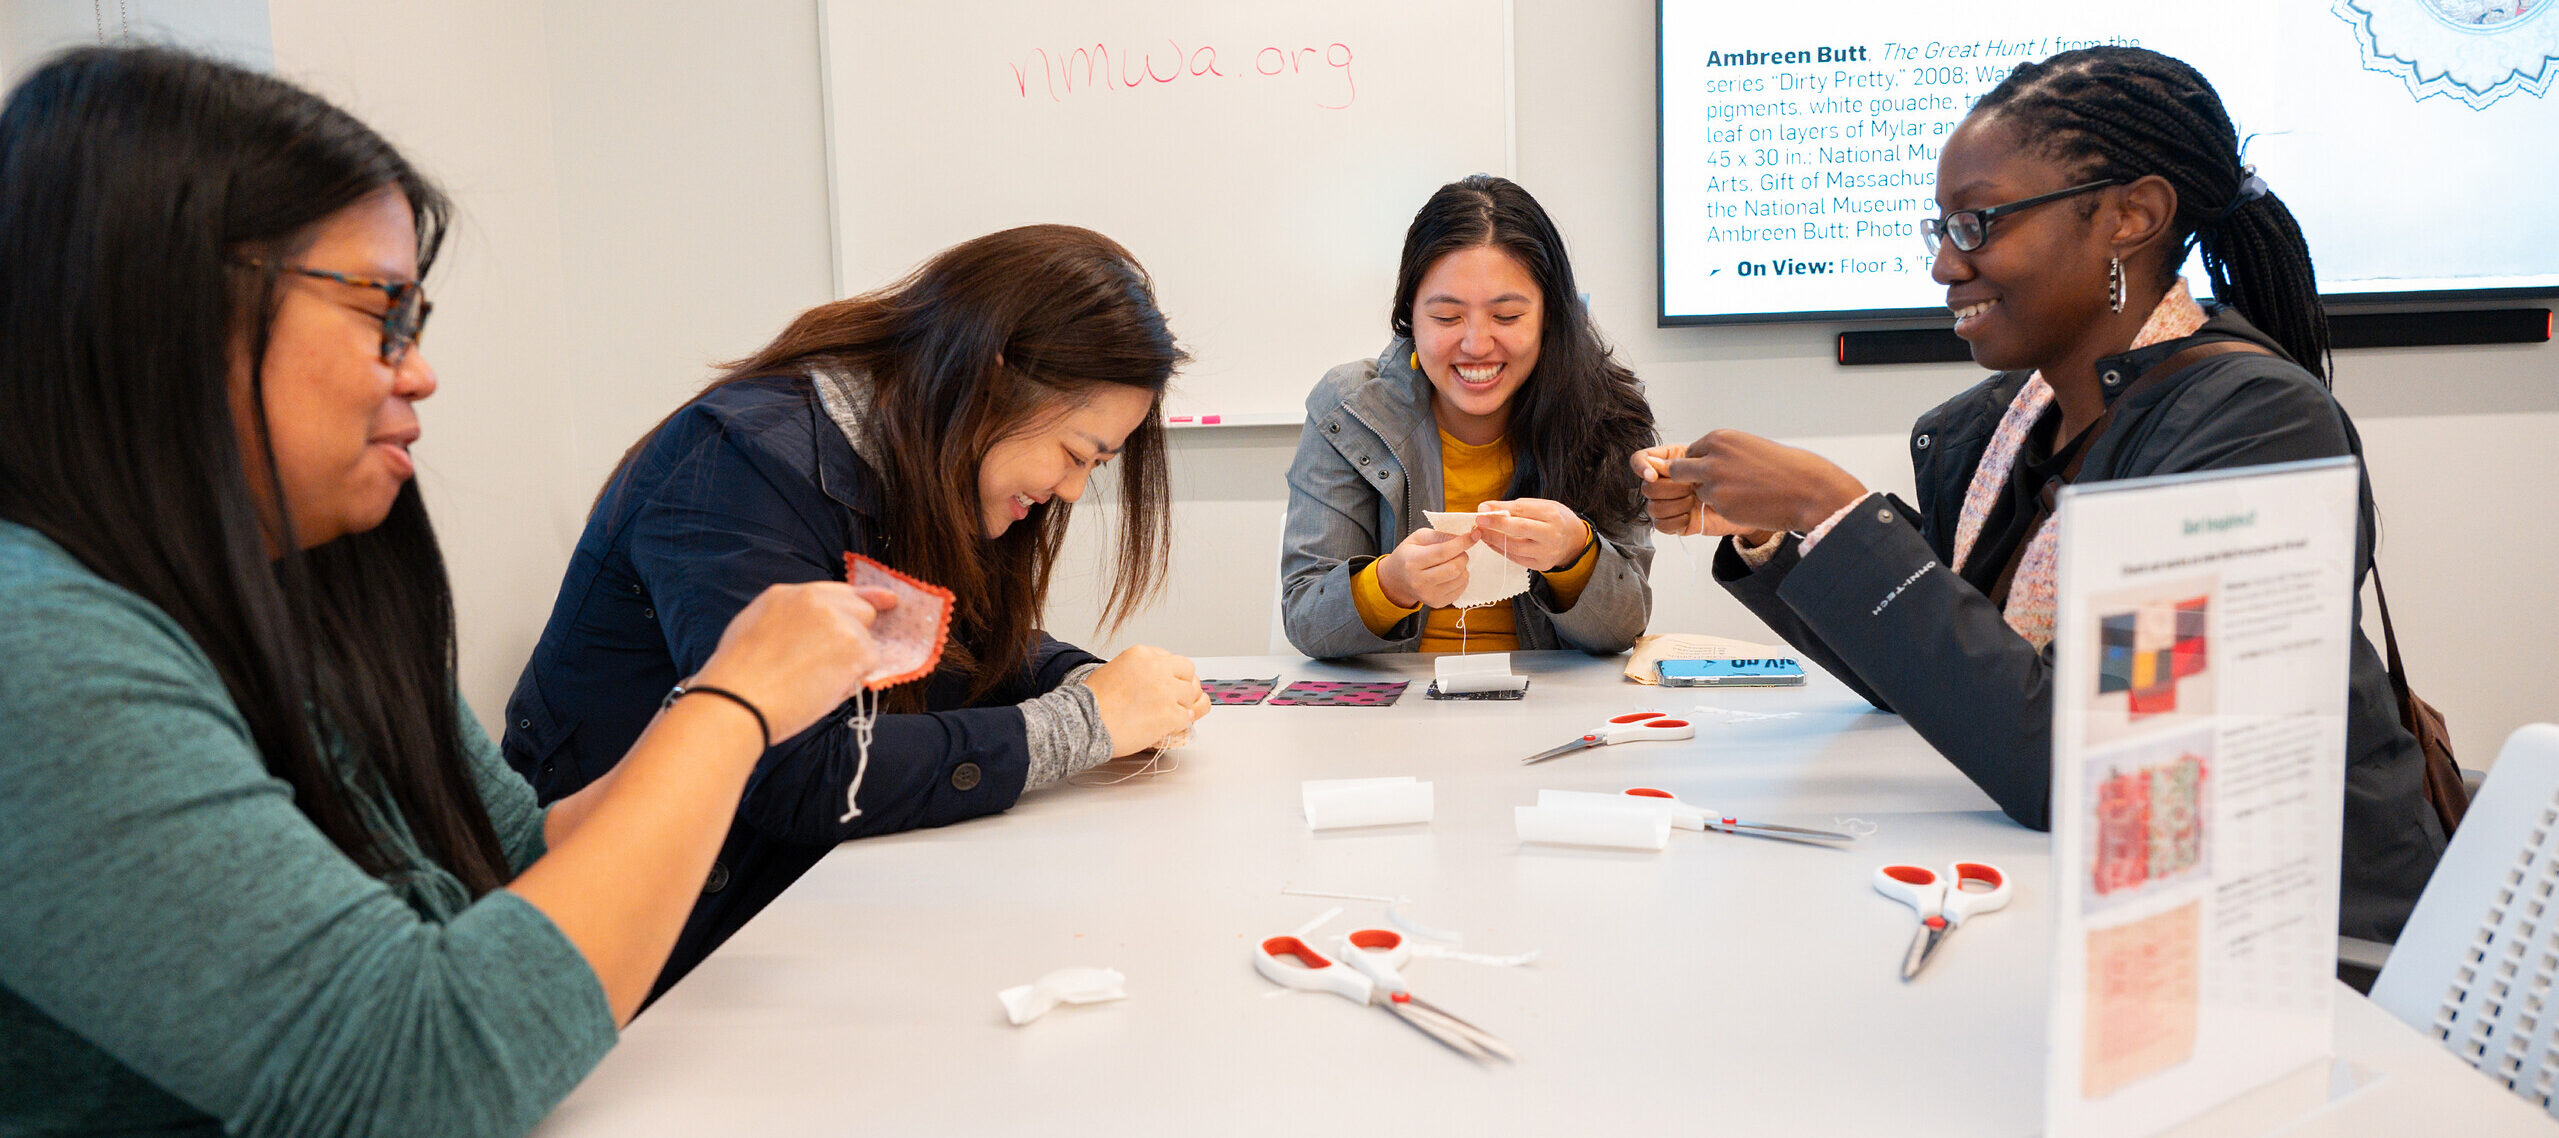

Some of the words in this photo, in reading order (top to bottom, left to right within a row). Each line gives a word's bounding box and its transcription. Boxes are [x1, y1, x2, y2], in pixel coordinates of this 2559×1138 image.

[1706, 49, 1811, 67] Ambreen
[1884, 42, 1919, 61] The
[1924, 40, 1980, 60] Great
[1985, 39, 2036, 57] Hunt
[1009, 39, 1355, 109] nmwa.org
[1706, 74, 1764, 94] series
[1913, 66, 1969, 87] 2008;
[1809, 97, 1863, 115] white
[1706, 124, 1744, 144] leaf
[1749, 130, 1773, 142] on
[1779, 123, 1840, 145] layers
[1845, 120, 1866, 139] of
[1870, 119, 1927, 142] Mylar
[1706, 150, 1732, 168] 45
[1738, 153, 1748, 167] x
[1754, 148, 1779, 167] 30
[1819, 144, 1901, 165] National
[1760, 172, 1795, 192] Gift
[1801, 171, 1821, 190] of
[1826, 168, 1936, 189] Massachus
[1707, 201, 1739, 218] the
[1744, 198, 1826, 217] National
[1832, 196, 1917, 214] Museum
[1707, 225, 1797, 243] Ambreen
[1856, 220, 1914, 238] Photo
[1737, 260, 1767, 277] On
[1772, 257, 1835, 276] View:
[1840, 256, 1888, 274] Floor
[1893, 256, 1910, 275] 3,
[1871, 560, 1937, 616] OMNI-TECH
